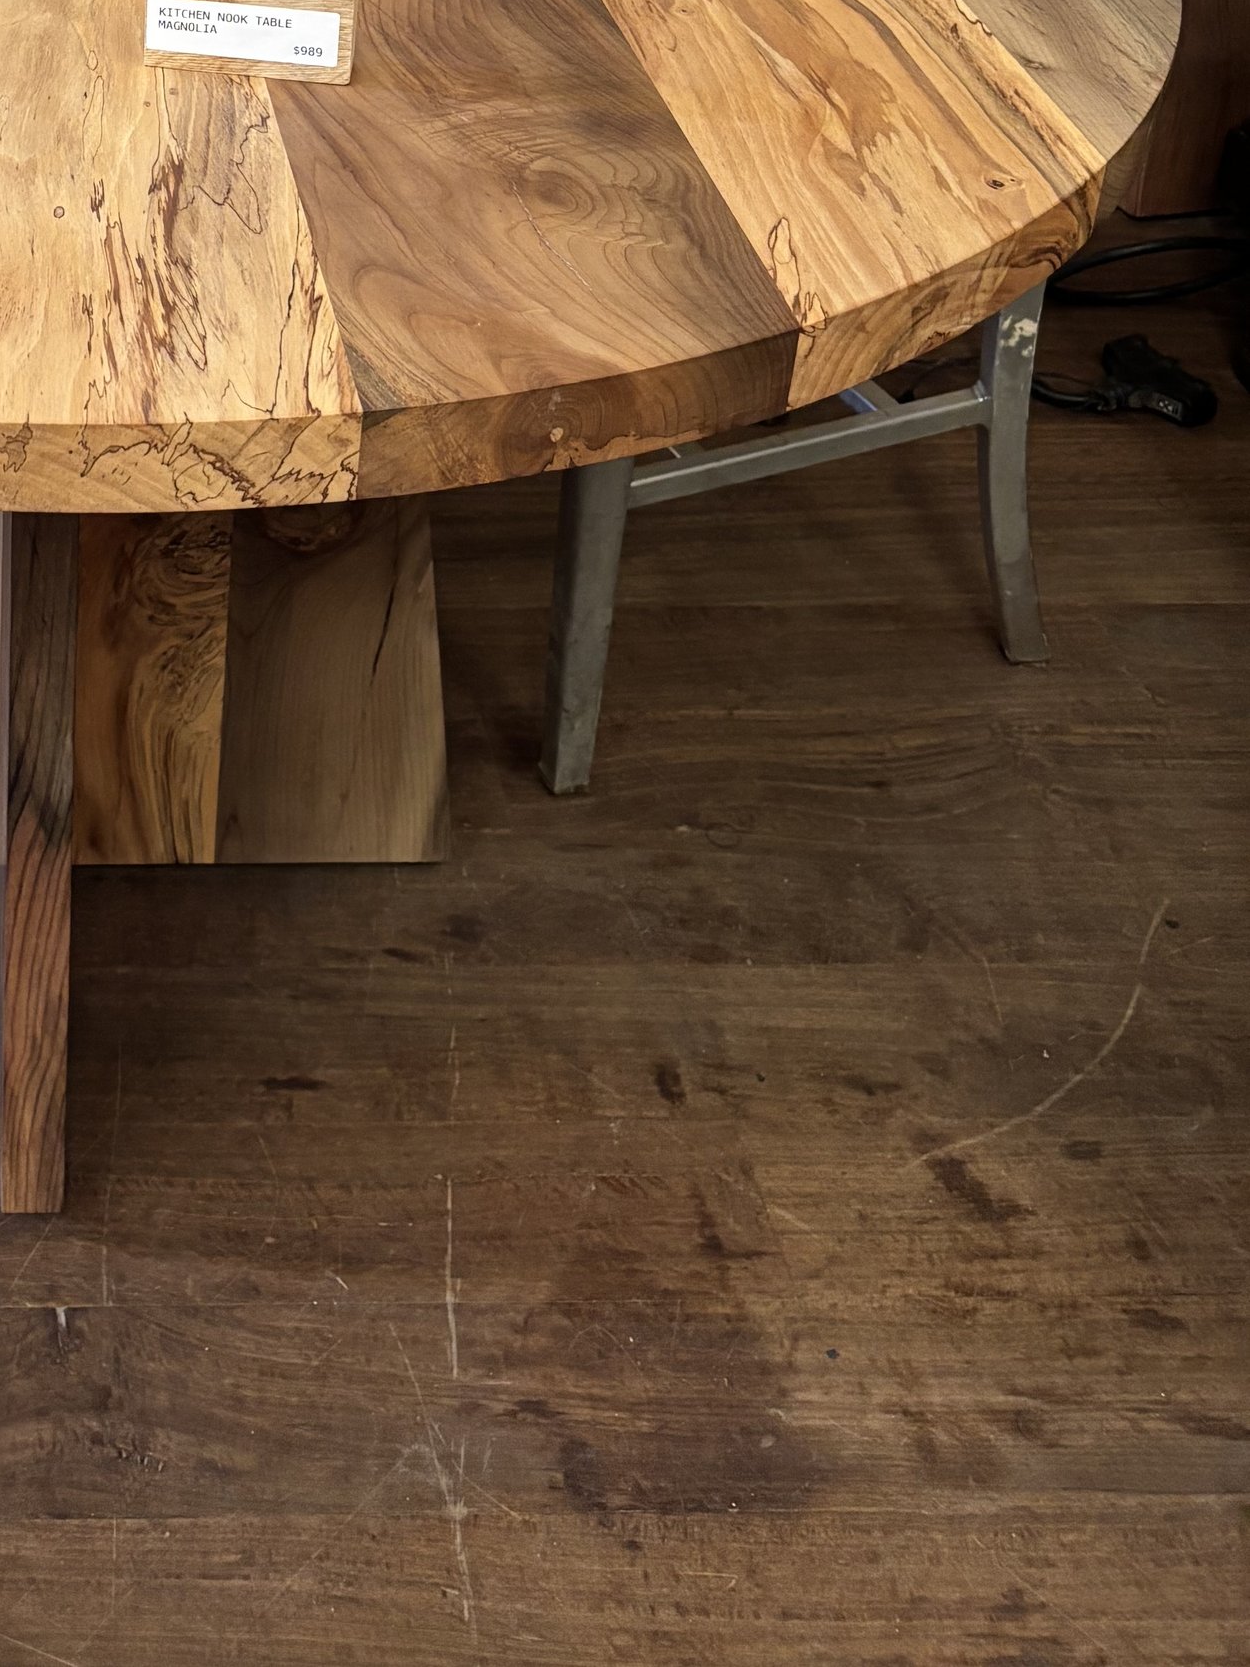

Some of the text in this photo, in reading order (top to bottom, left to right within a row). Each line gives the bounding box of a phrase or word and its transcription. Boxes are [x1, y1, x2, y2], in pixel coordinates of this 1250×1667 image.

[159, 7, 292, 29] KITCHEN NOOK TABLE
[158, 21, 218, 34] MAGNOLIA
[293, 46, 323, 58] $989
